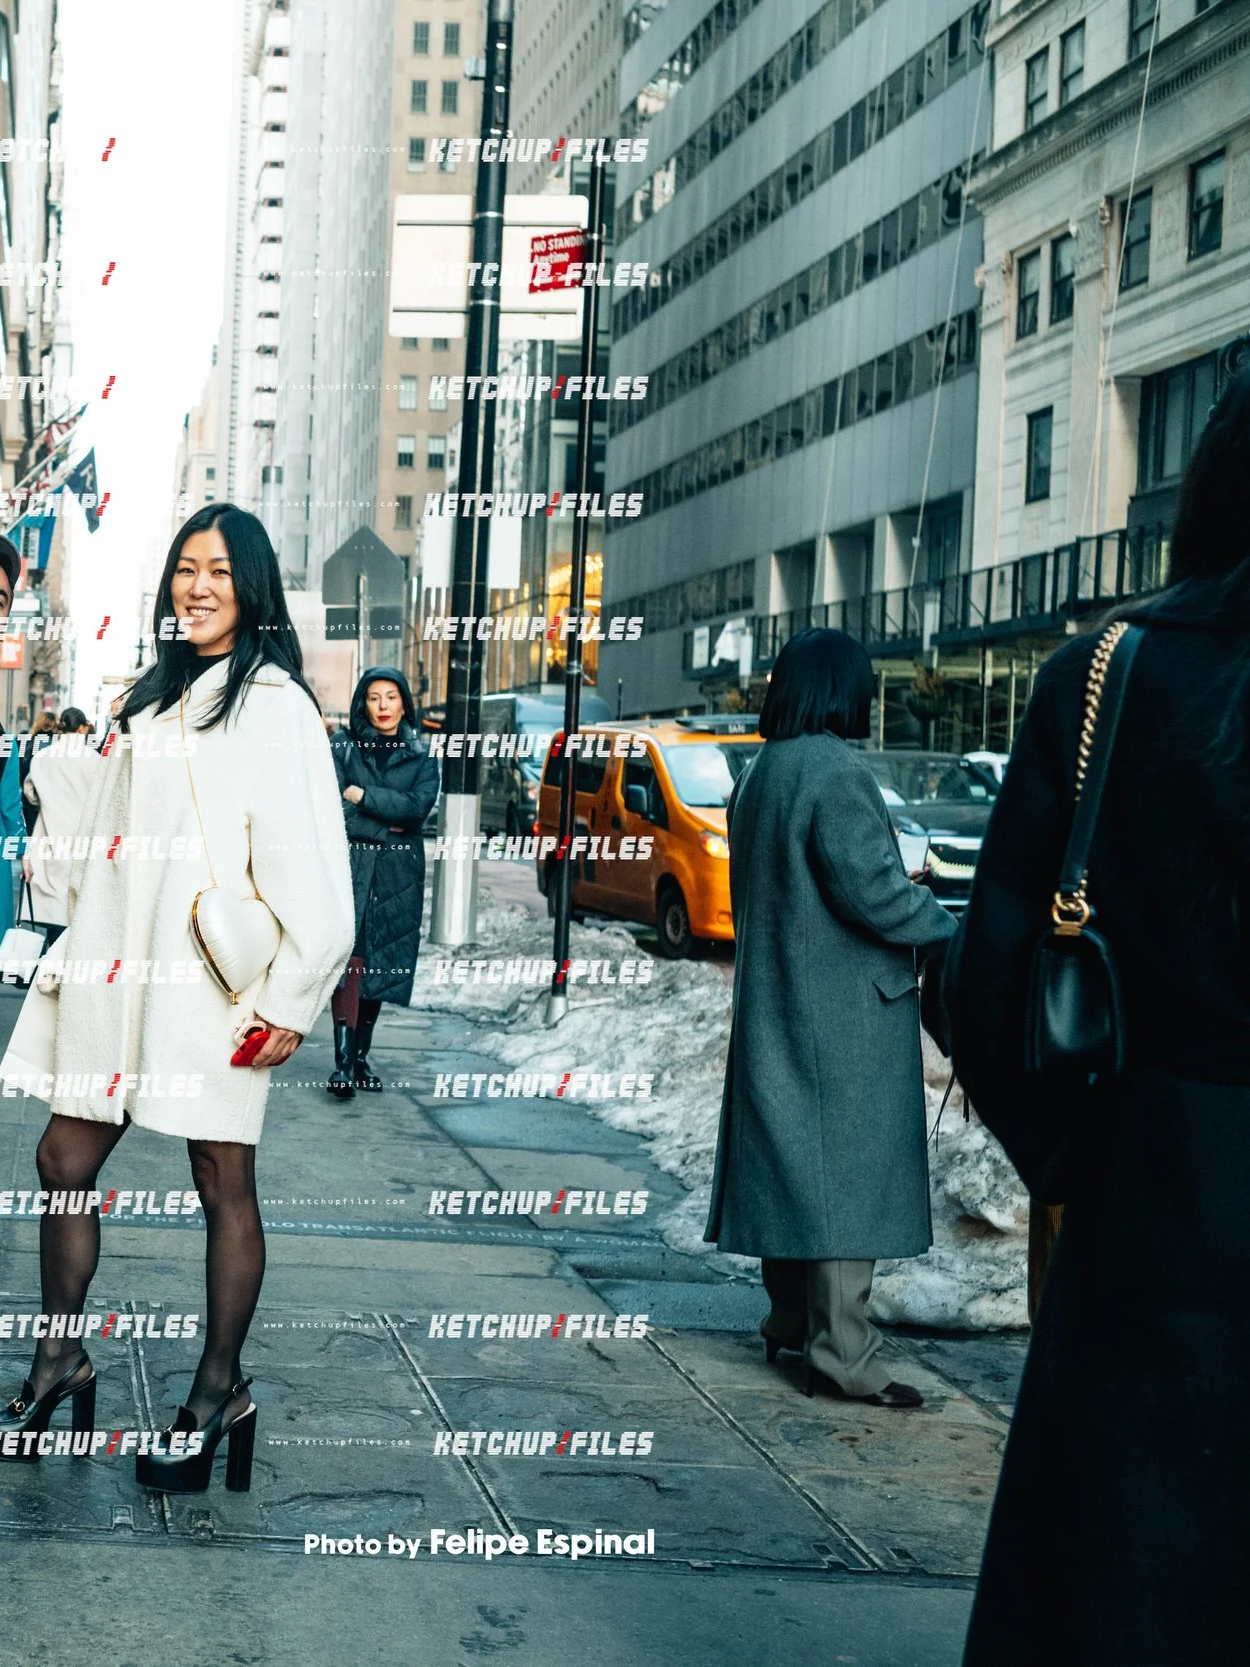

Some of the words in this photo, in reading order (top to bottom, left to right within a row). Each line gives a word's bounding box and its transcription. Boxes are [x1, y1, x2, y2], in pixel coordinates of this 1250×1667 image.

[533, 239, 547, 253] NO
[533, 251, 570, 265] Anytime
[261, 1220, 295, 1228] OLO
